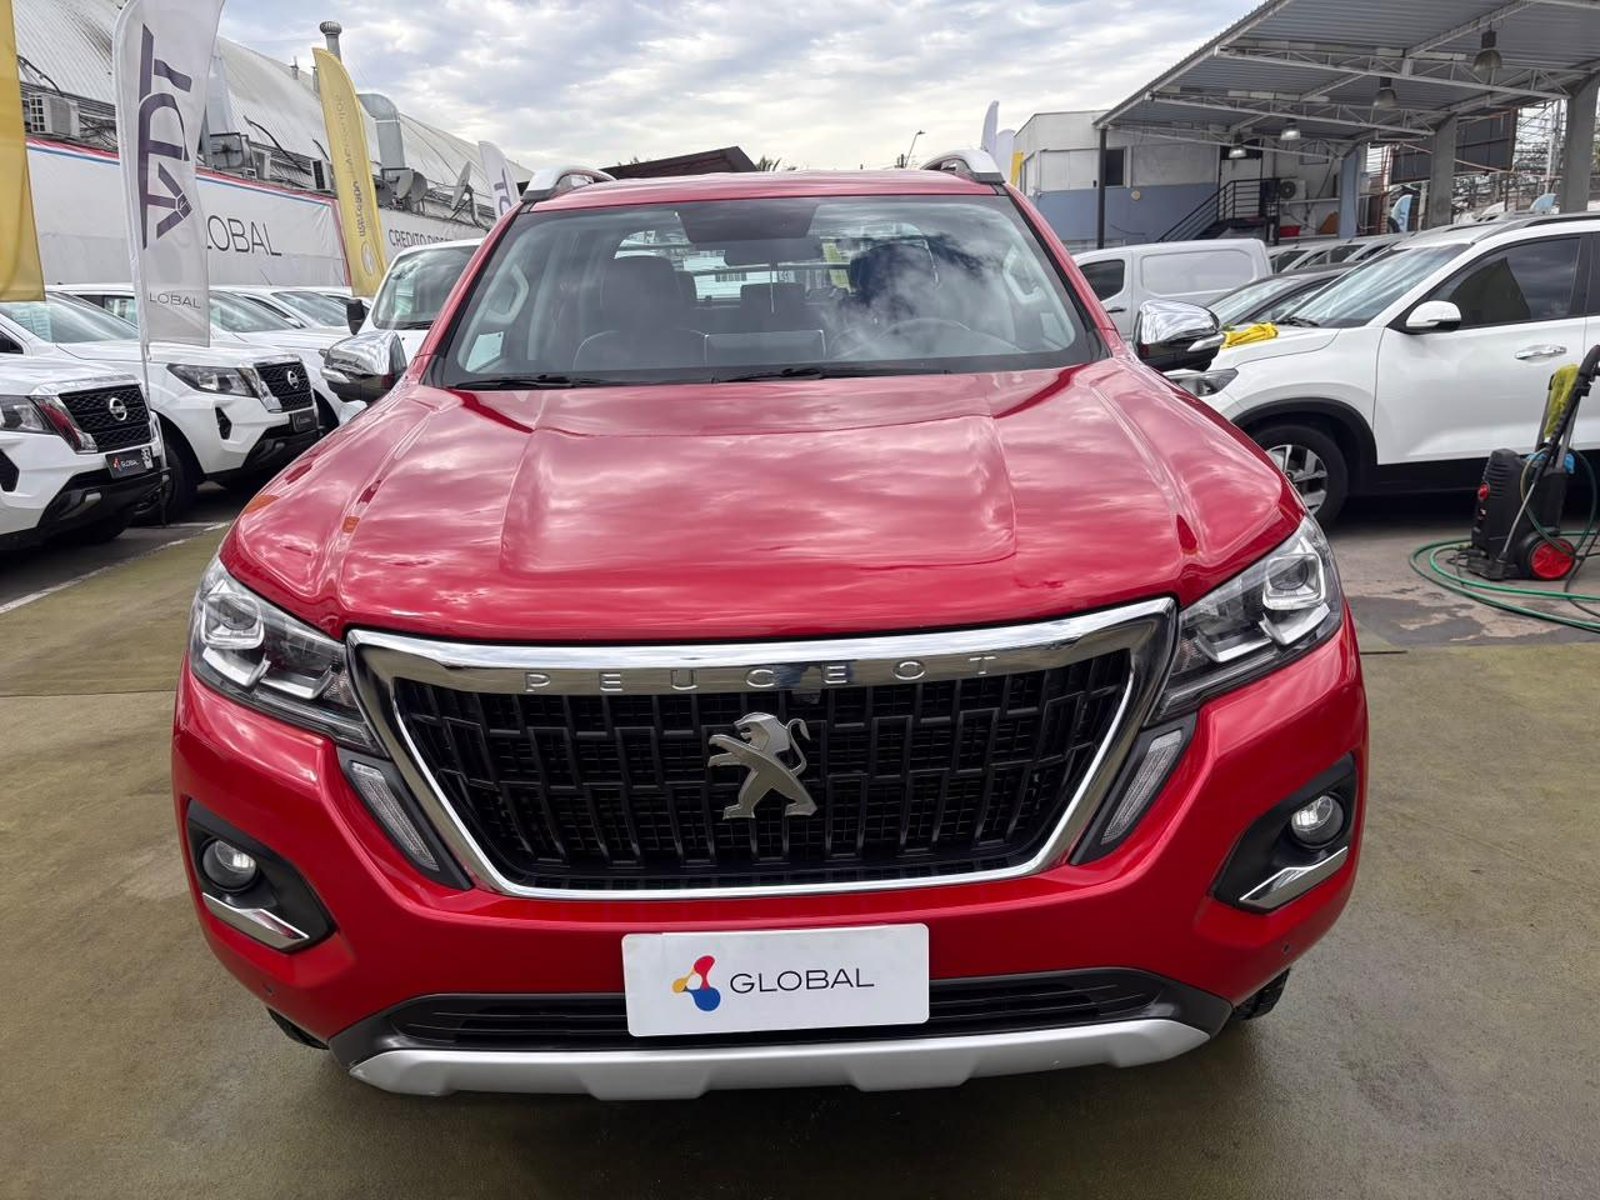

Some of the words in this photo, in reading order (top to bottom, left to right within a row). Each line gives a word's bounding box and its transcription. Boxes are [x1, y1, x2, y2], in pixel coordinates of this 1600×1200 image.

[207, 215, 282, 256] OBAL
[524, 655, 998, 693] PEUGEOT
[729, 967, 875, 994] GLOBAL
